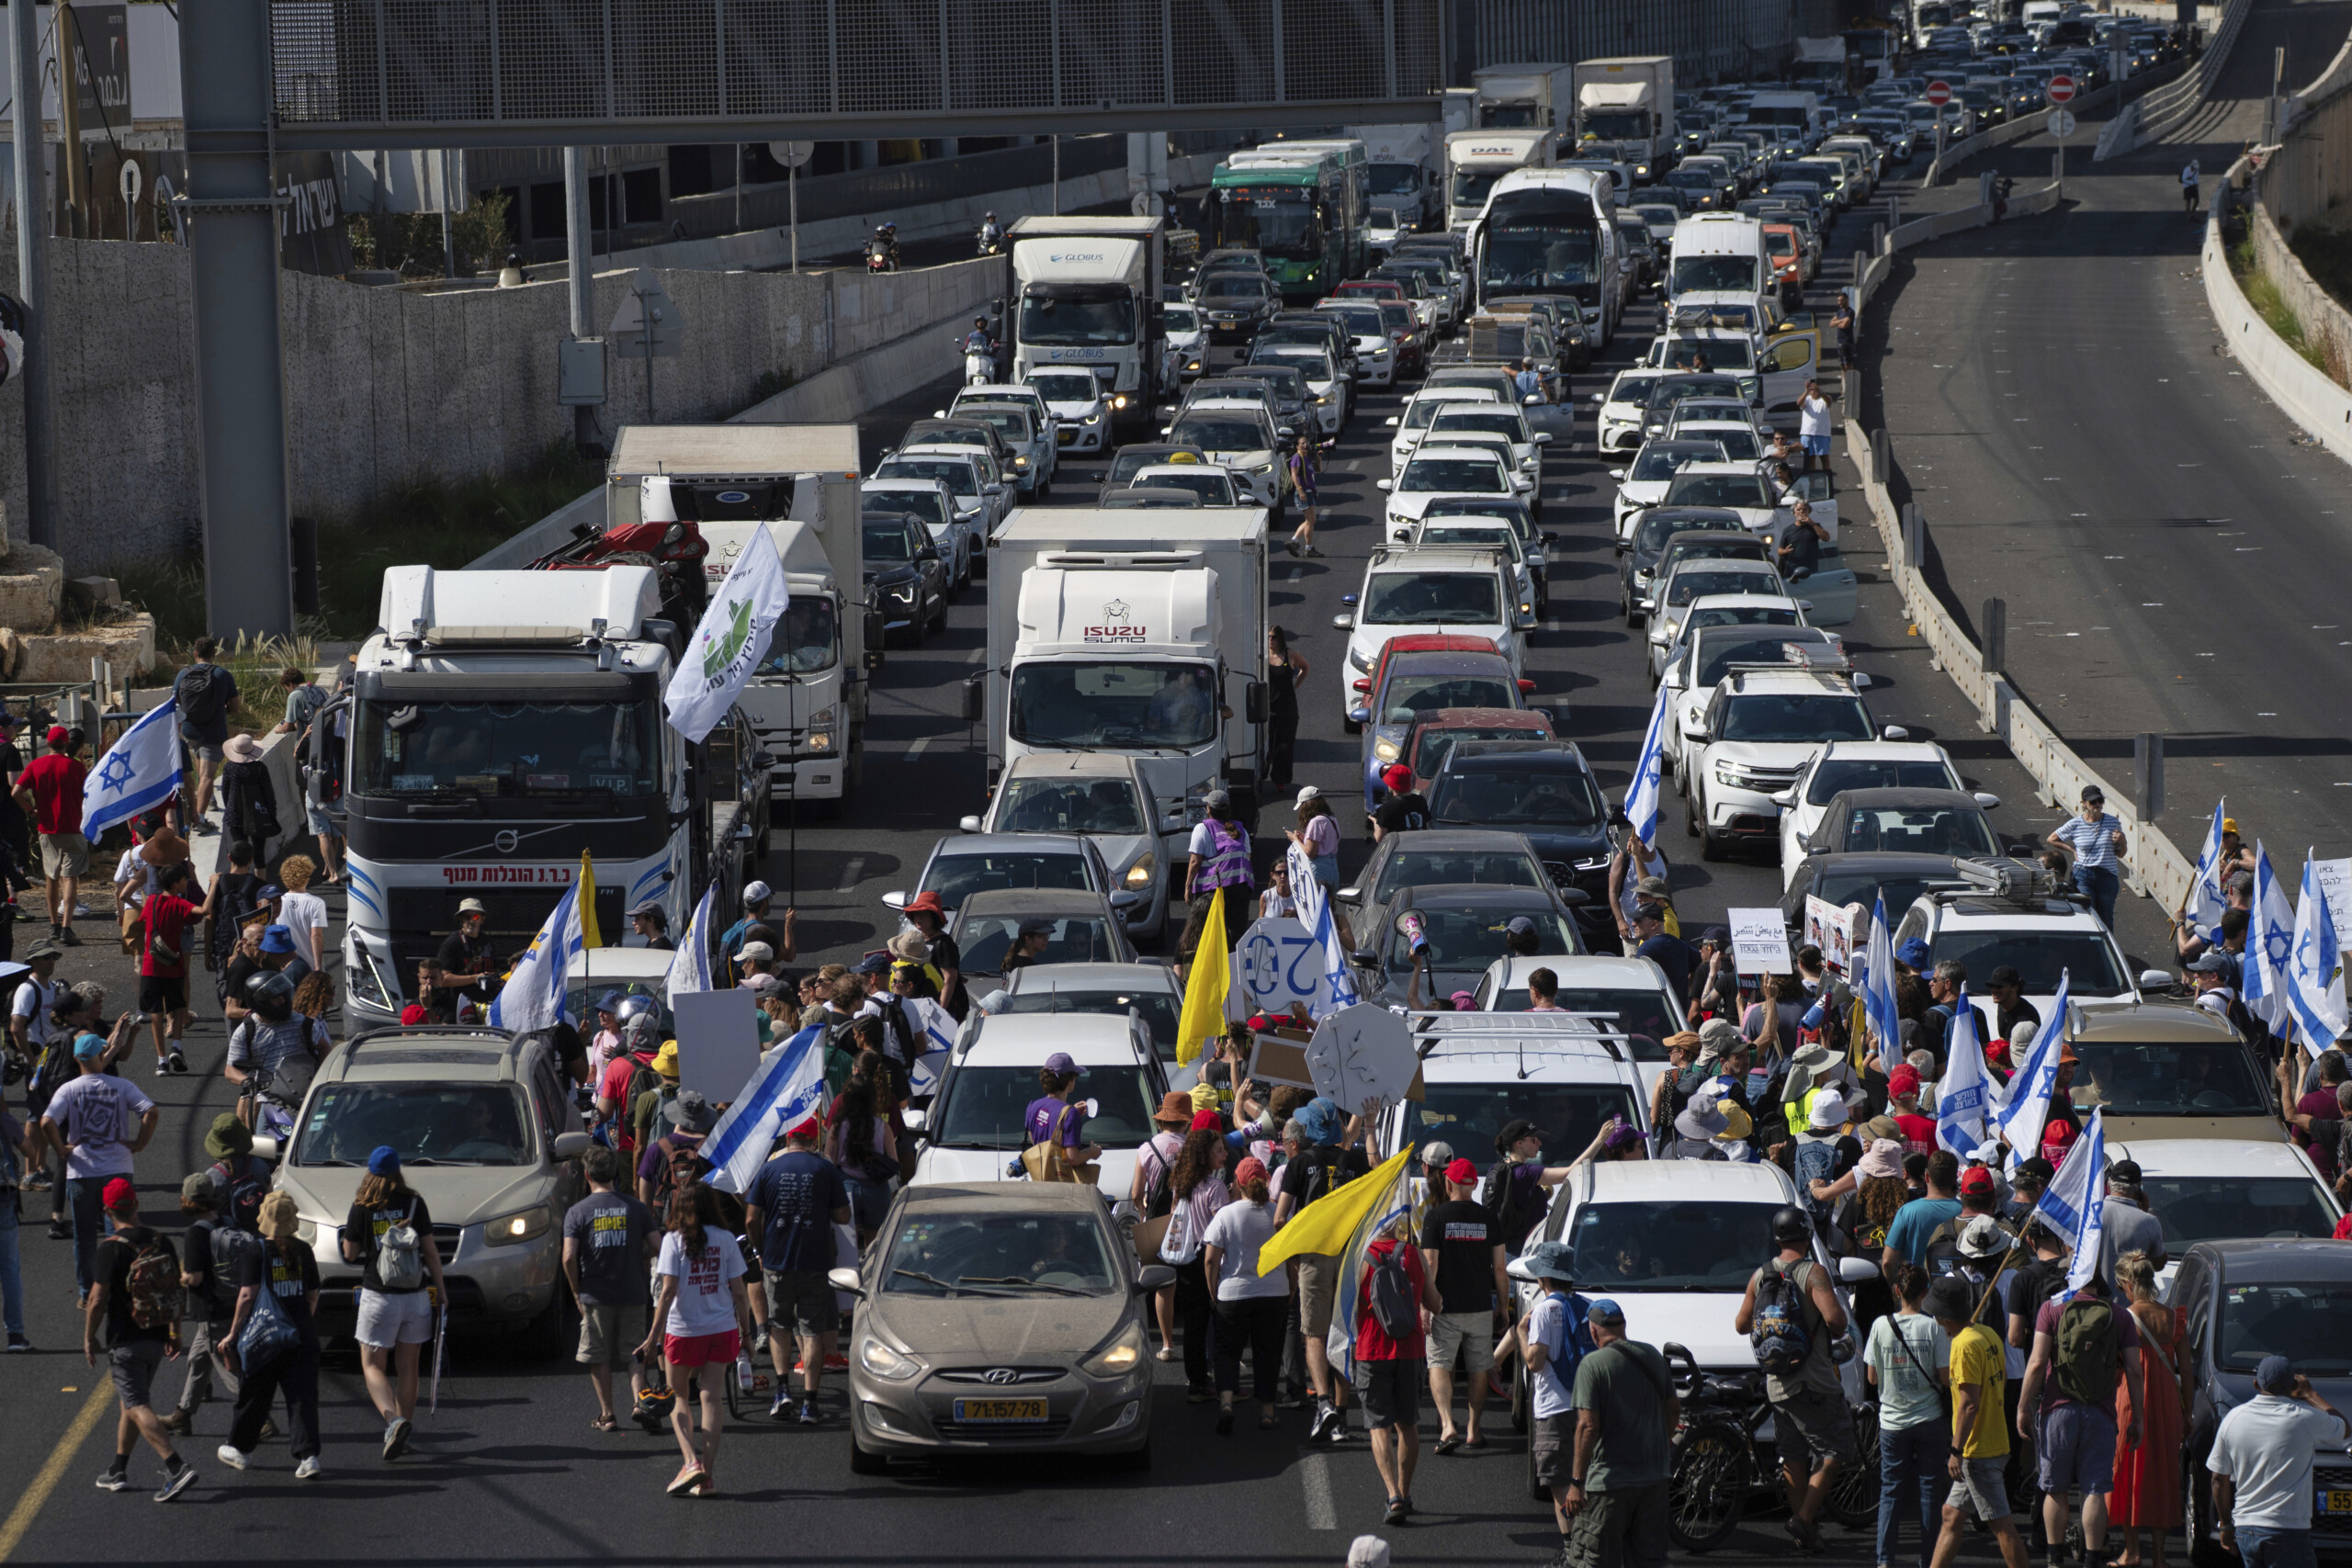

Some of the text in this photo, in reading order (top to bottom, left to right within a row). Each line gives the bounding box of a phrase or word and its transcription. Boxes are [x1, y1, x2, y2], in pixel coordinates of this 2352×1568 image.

[1065, 349, 1104, 359] GLOBUS
[1084, 626, 1147, 637] ISUZU
[444, 866, 478, 885] מנוף
[481, 865, 534, 883] הובלות
[594, 1207, 627, 1217] ALL THEM
[594, 1215, 628, 1233] HOME!
[690, 1257, 720, 1274] כולם
[274, 1280, 303, 1297] NOW!
